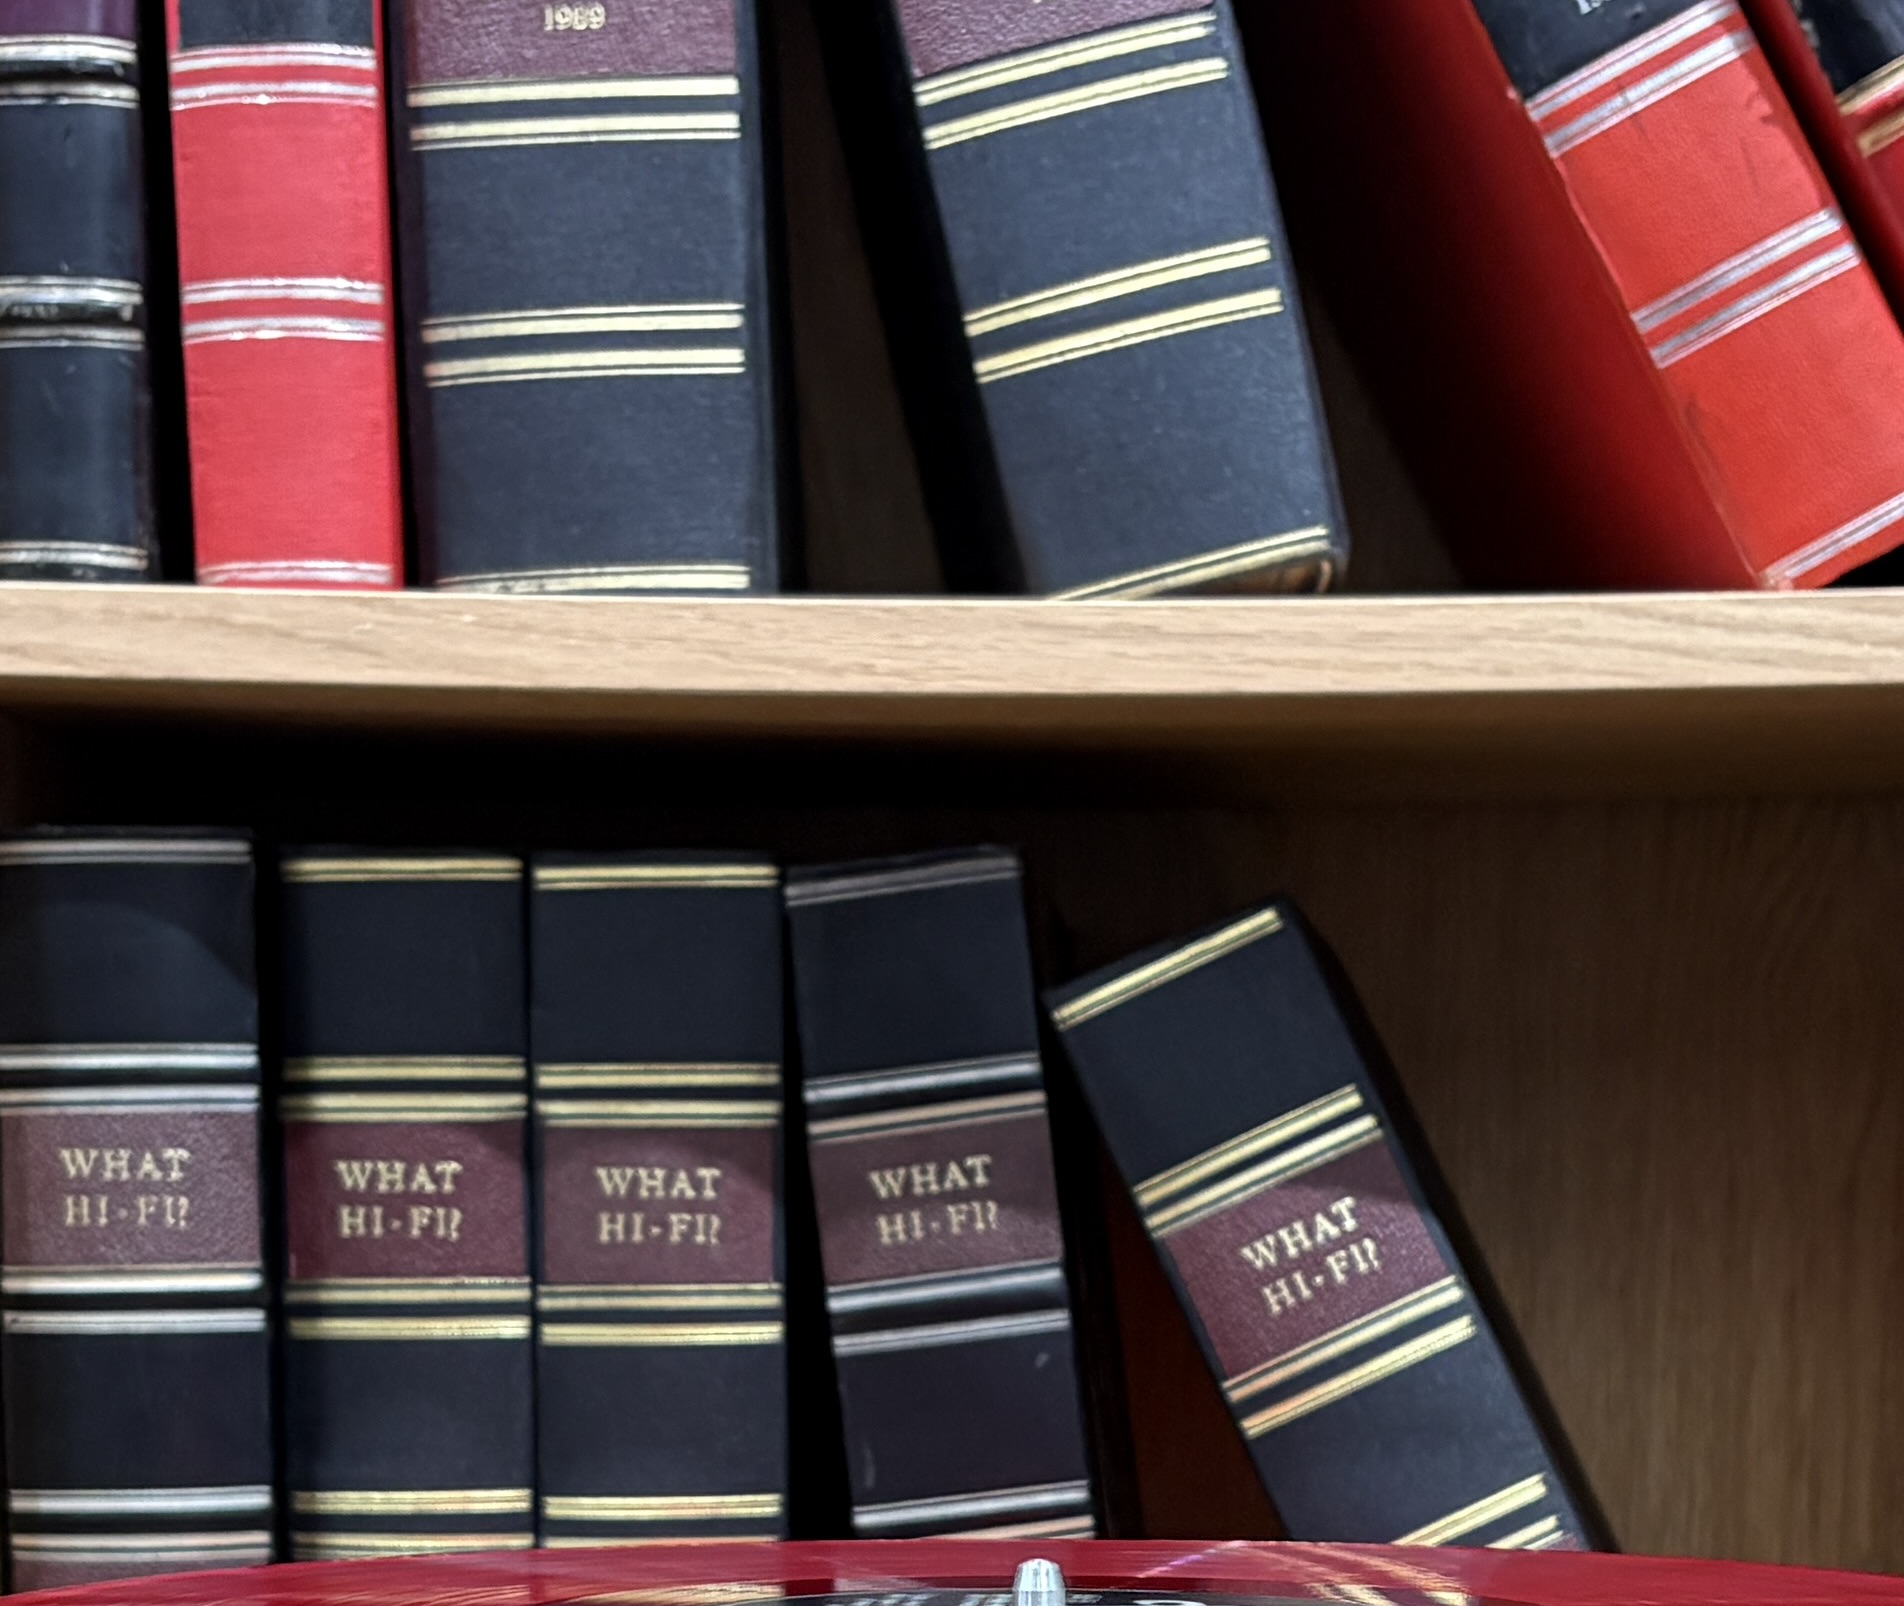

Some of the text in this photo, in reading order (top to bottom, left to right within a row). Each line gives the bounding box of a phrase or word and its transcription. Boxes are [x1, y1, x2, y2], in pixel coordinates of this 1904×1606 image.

[544, 4, 606, 31] 1989
[60, 1147, 191, 1182] WHAT
[334, 1160, 463, 1195] WHAT
[869, 1154, 992, 1200] WHAT
[595, 1167, 721, 1199] WHAT
[1241, 1195, 1358, 1270] WHAT
